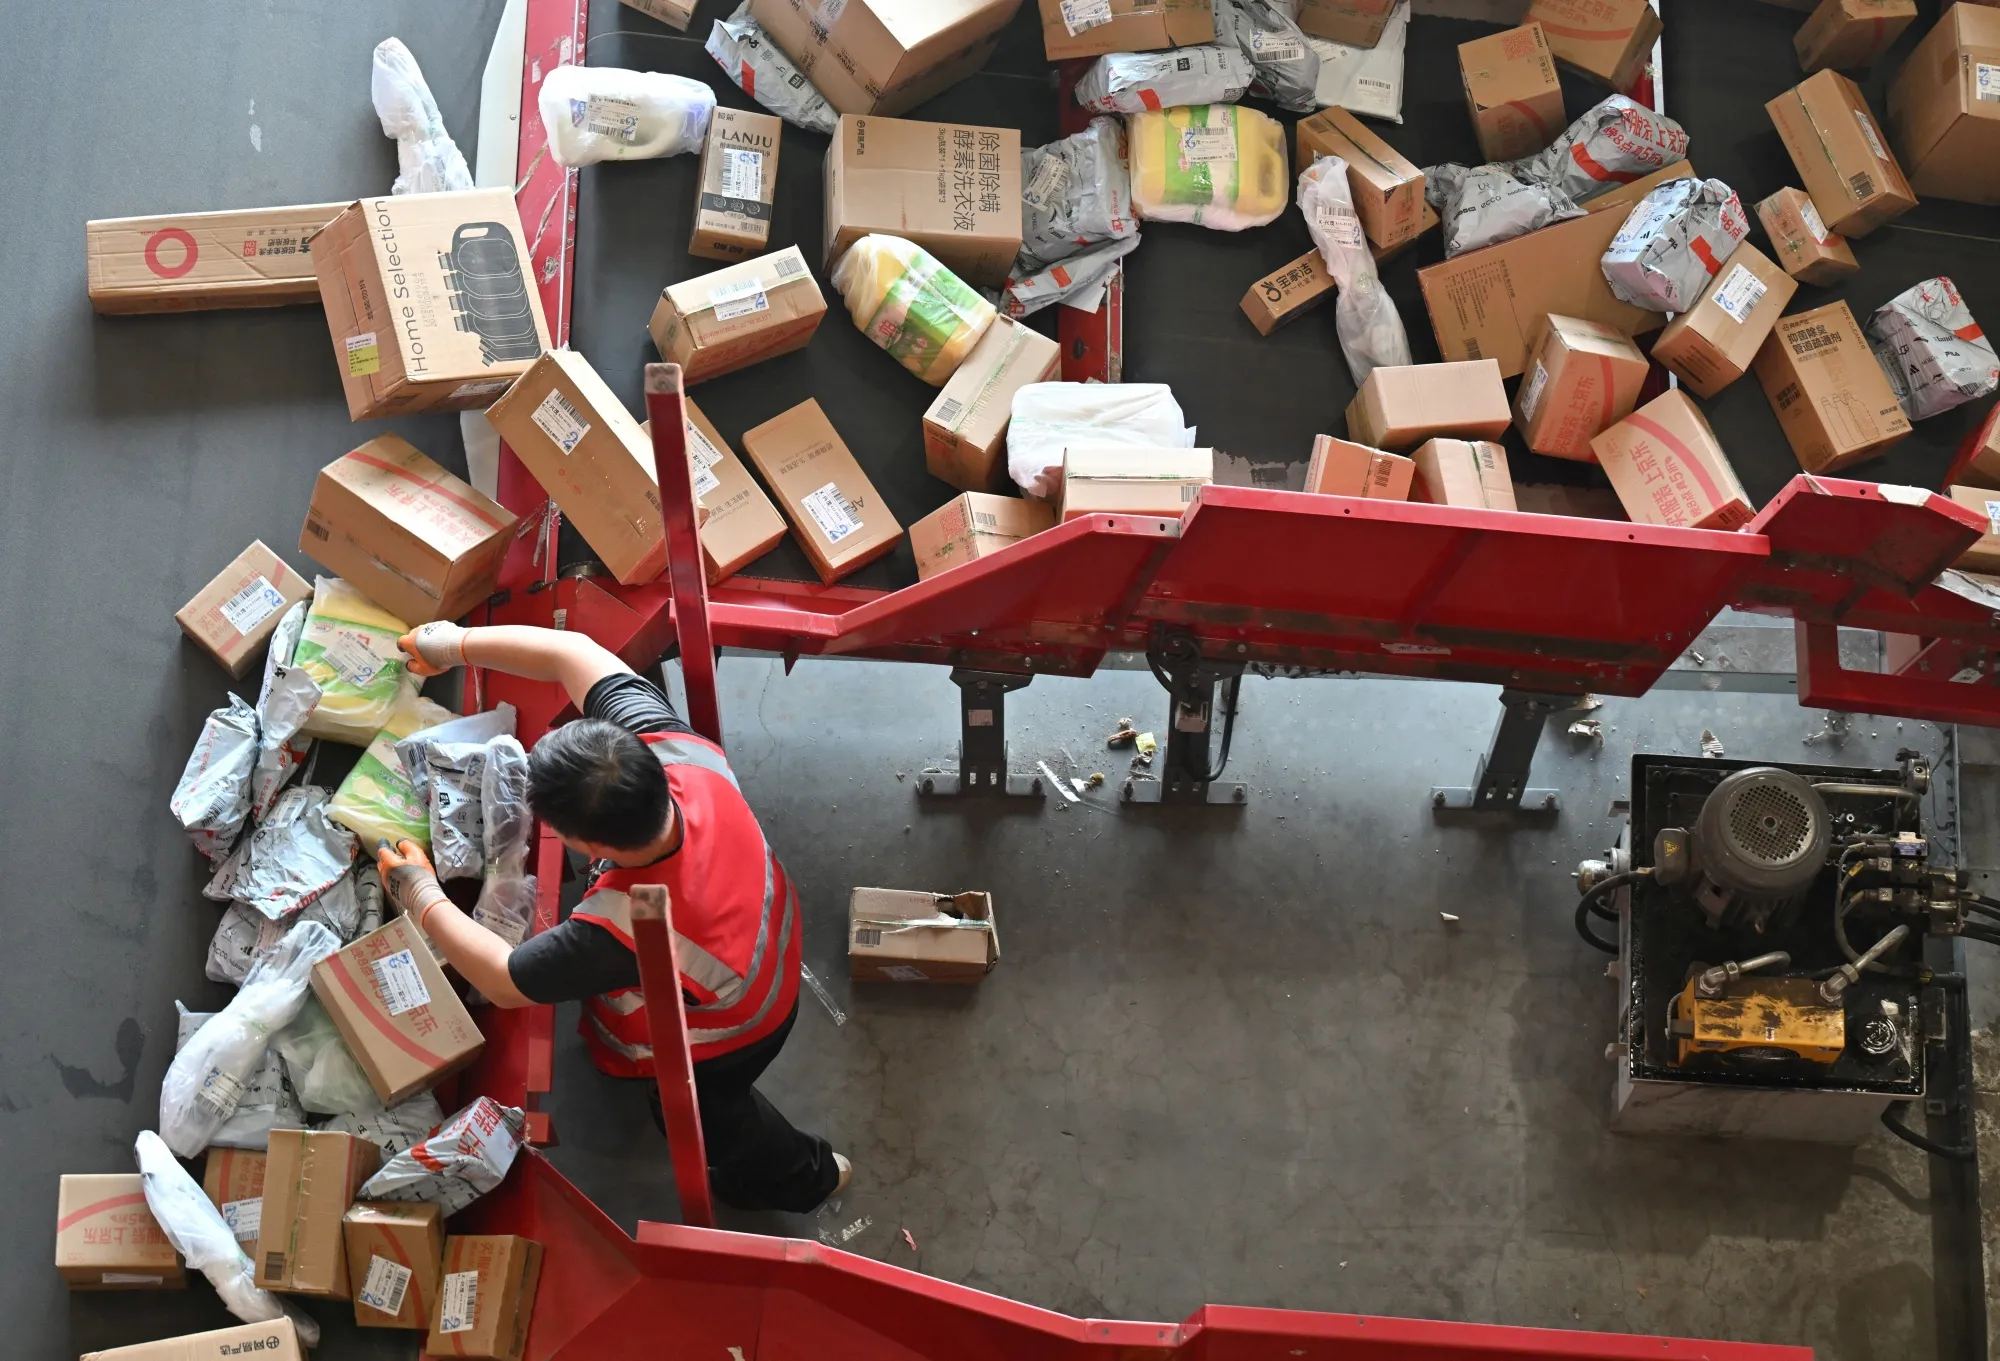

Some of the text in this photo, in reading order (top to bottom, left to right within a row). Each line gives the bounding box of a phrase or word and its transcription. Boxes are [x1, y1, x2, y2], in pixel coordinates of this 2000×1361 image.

[722, 129, 772, 148] LANJU
[1602, 124, 1661, 165] 晚8点 真5折
[1655, 123, 1687, 158] 上京东
[952, 129, 977, 232] 酵素洗衣液
[977, 130, 1001, 213] 除菌除螨
[1477, 183, 1492, 191] UR
[1480, 195, 1502, 208] ecco
[375, 198, 428, 373] Home Selection
[1276, 261, 1312, 289] 宝家洁
[1716, 294, 1737, 313] 2
[1787, 326, 1827, 344] 抑菌除臭
[1792, 332, 1842, 355] 管道疏通剂
[1847, 322, 1866, 350] CLEANER
[1569, 375, 1594, 414] 上京东
[1628, 441, 1665, 487] 上京东
[1663, 461, 1703, 520] 晚8点 真5折
[262, 586, 283, 609] 2
[350, 945, 374, 979] 晚8点
[387, 951, 411, 971] 2
[82, 1227, 128, 1245] 上京东
[363, 1292, 385, 1307] 2
[443, 1317, 460, 1329] 2
[219, 1339, 265, 1357] 网易严选
